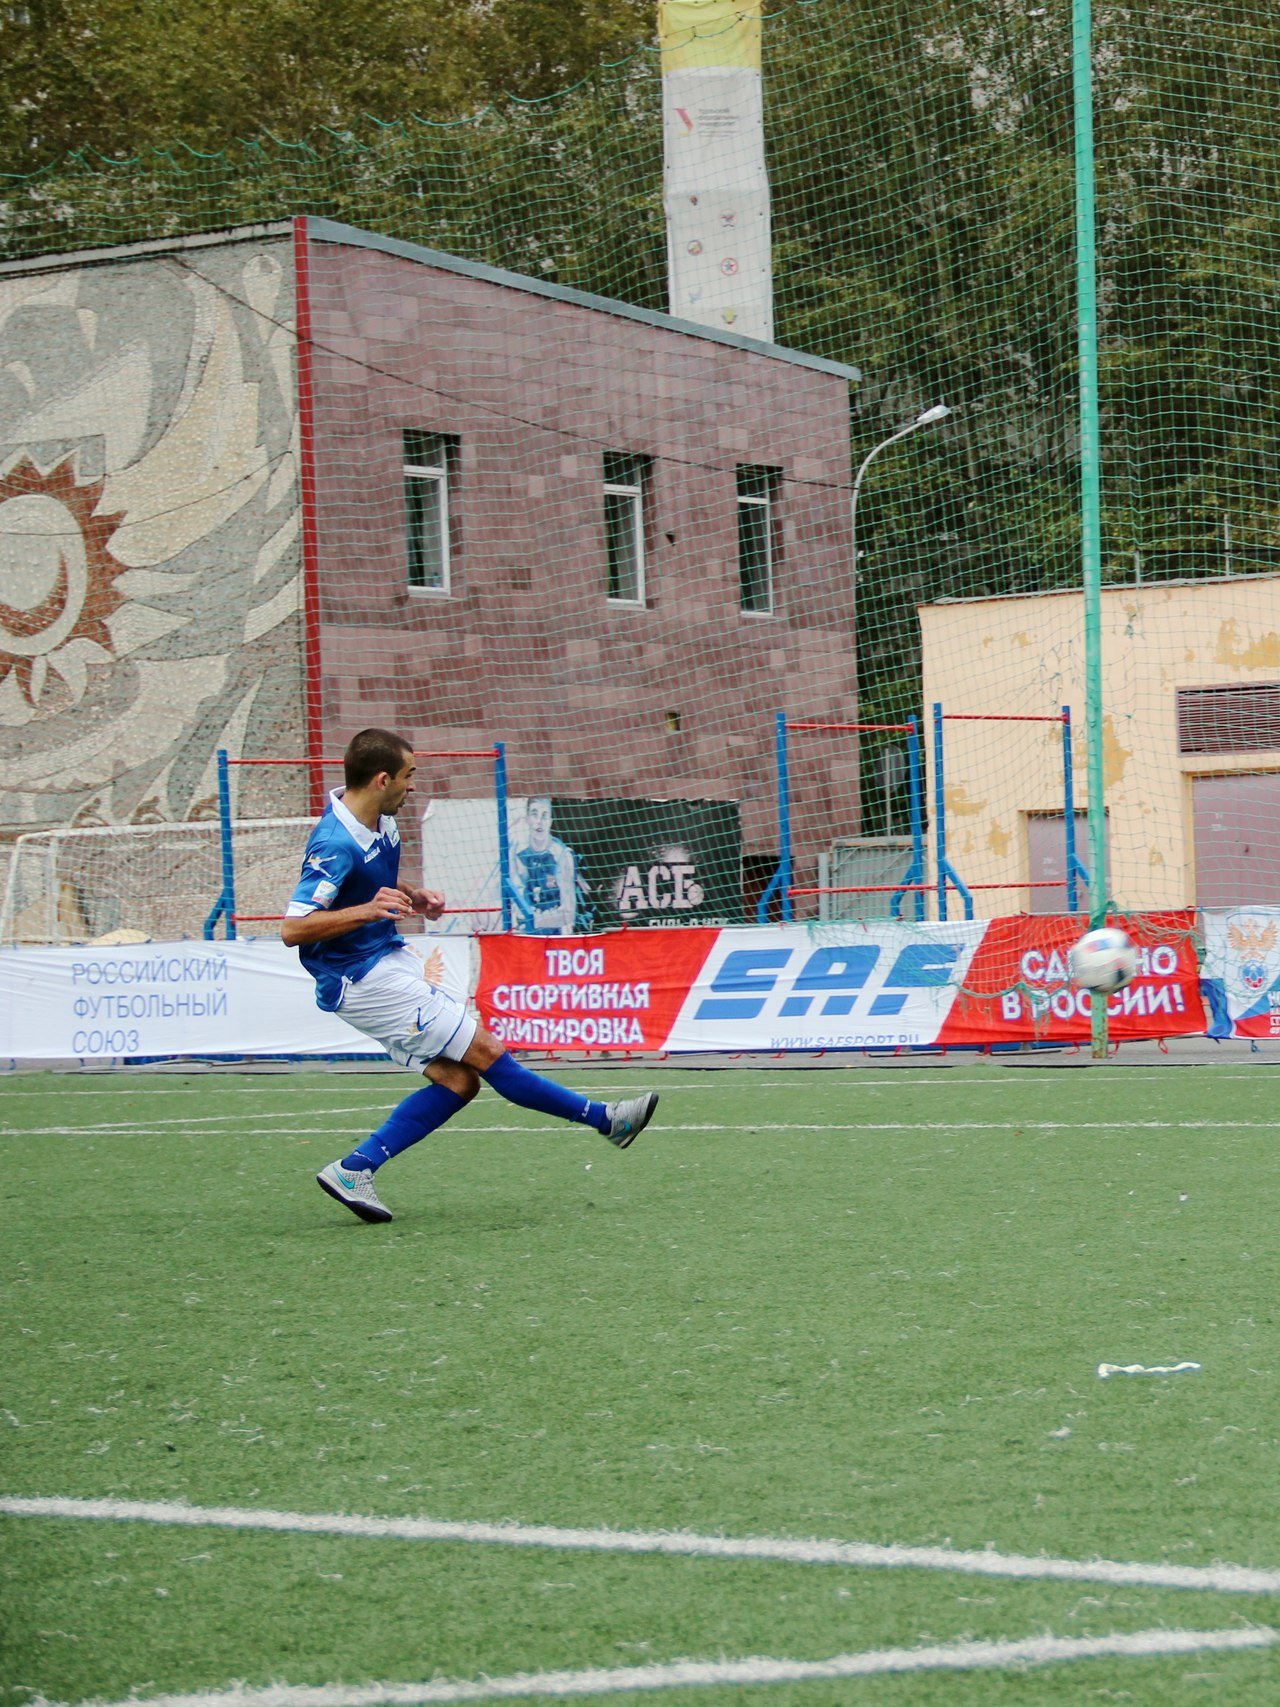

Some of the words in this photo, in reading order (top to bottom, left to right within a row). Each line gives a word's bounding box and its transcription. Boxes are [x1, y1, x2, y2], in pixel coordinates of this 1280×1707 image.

[71, 952, 228, 985] РОССИЙСКИЙ
[545, 948, 605, 977] ТВОЯ
[1020, 945, 1178, 982] СДНО
[492, 982, 650, 1011] СПОРТИВНАЯ
[693, 944, 966, 1020] SAF
[72, 987, 229, 1020] ФУТБОЛЬНЫЙ
[1001, 991, 1022, 1020] В
[71, 1029, 140, 1054] СОЮЗ
[489, 1016, 645, 1044] ЭКИПИРОВКА
